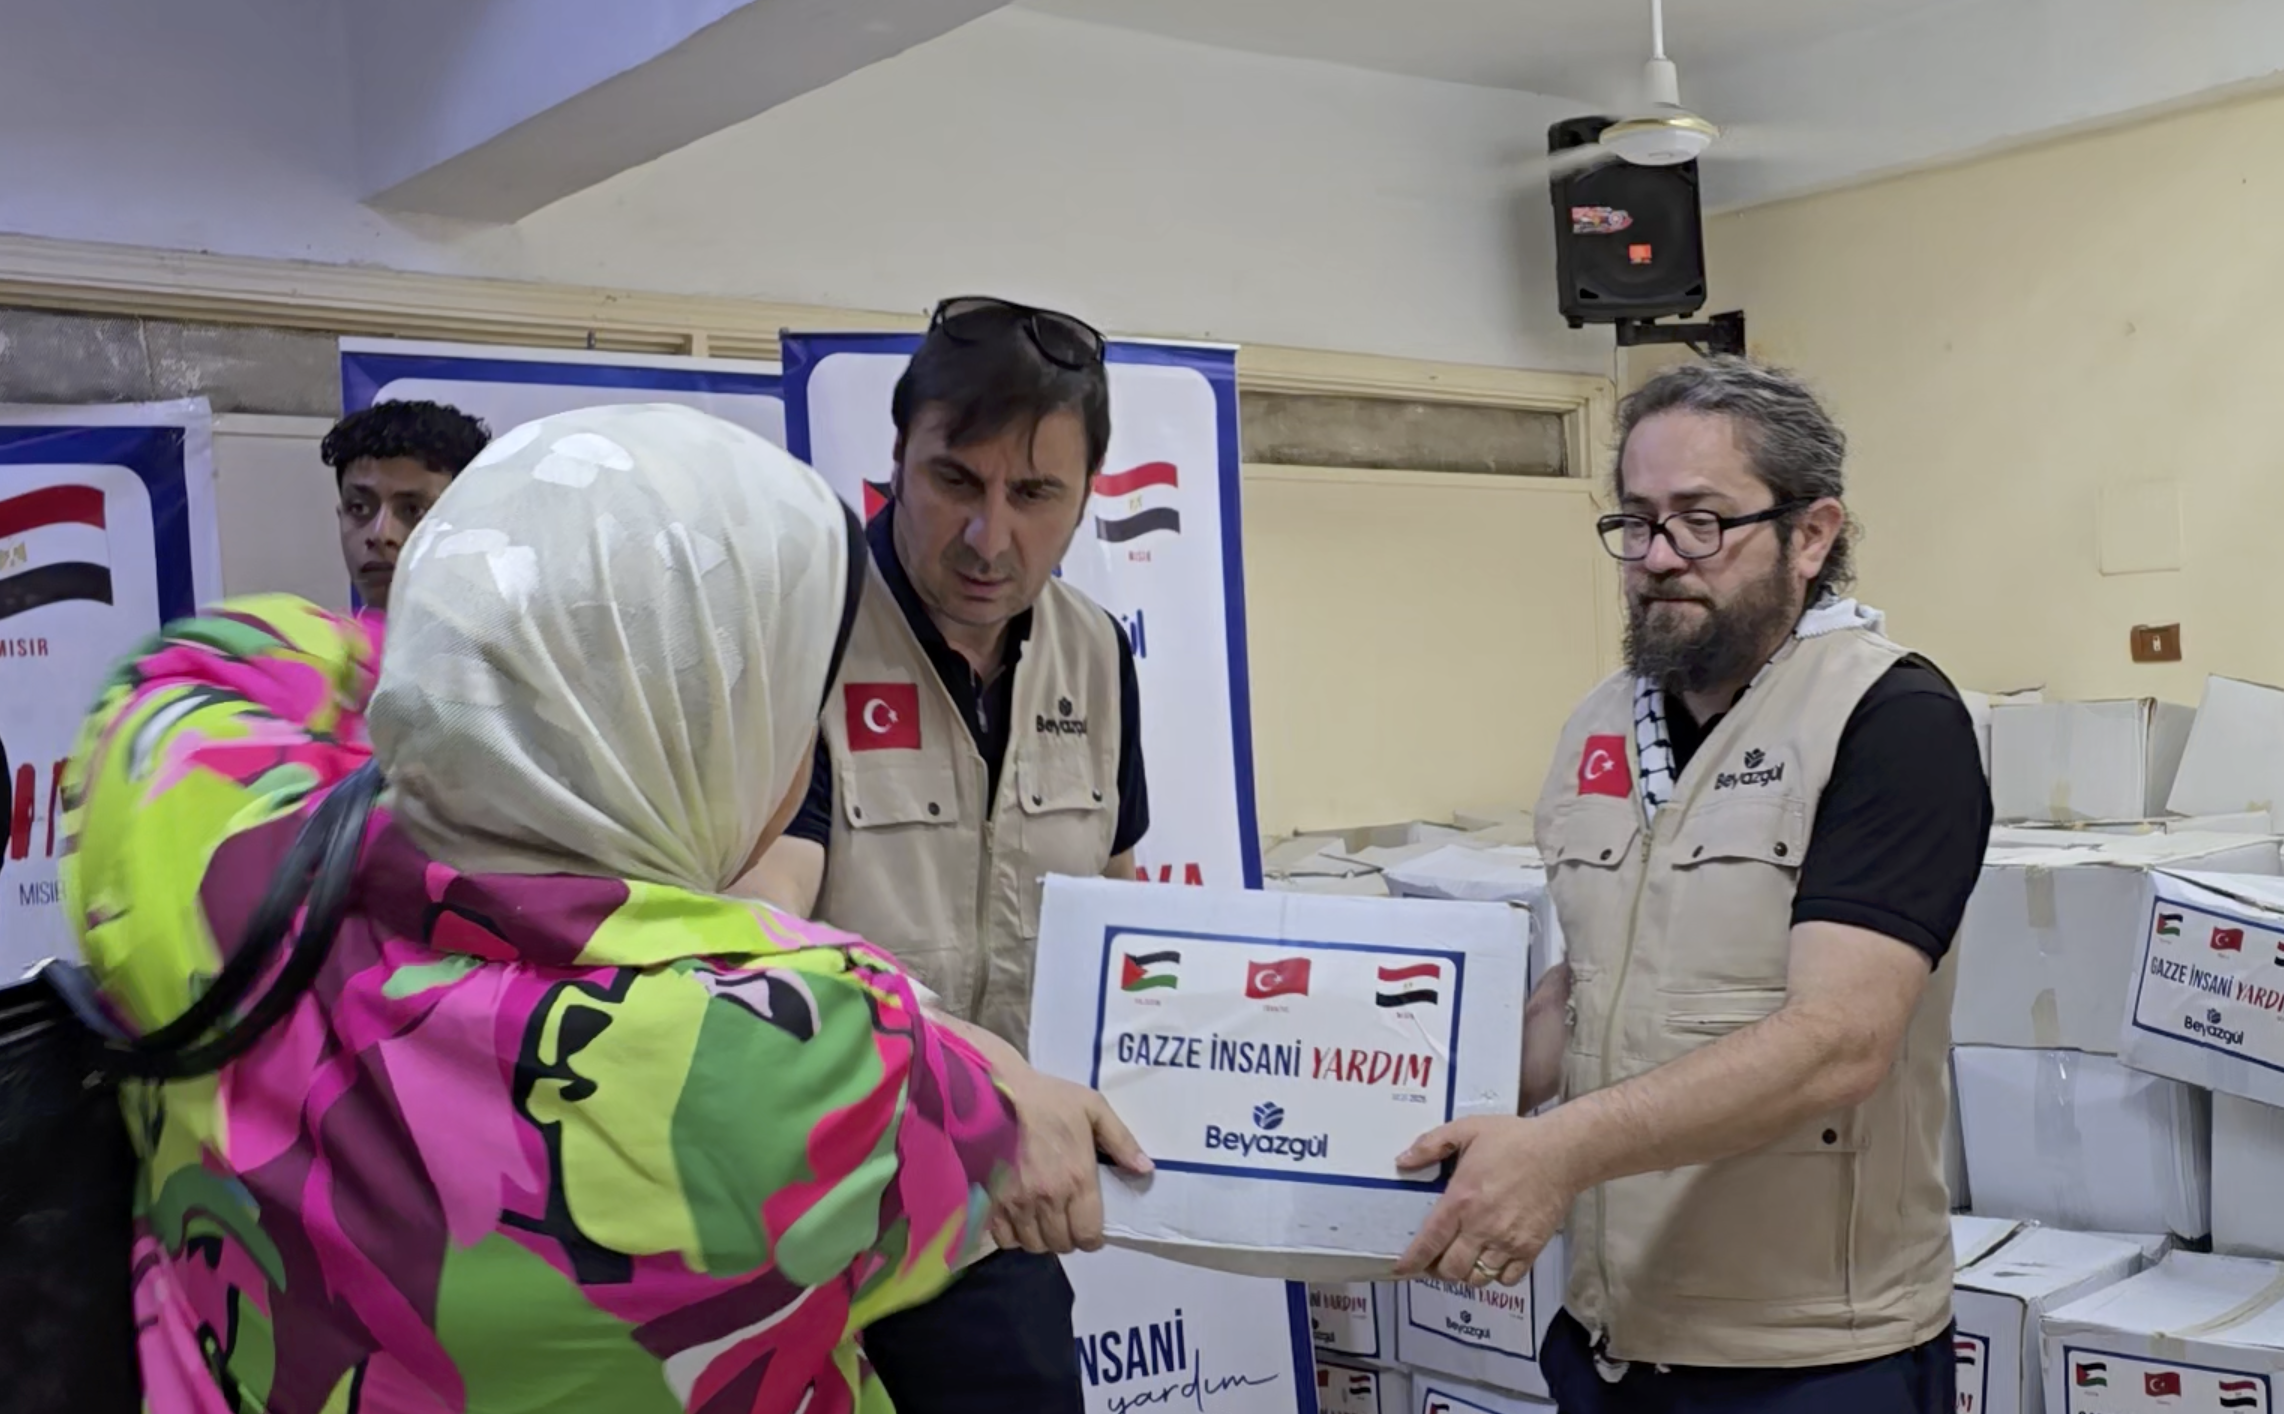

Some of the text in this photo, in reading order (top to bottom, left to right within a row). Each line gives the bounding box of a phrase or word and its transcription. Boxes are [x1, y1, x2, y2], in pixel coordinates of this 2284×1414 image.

[2150, 956, 2284, 1012] GAZZE İNSANİ YARDI
[2184, 1015, 2245, 1046] Beyazgül
[1118, 1032, 1433, 1088] GAZZE İNSANİ YARDIM
[1205, 1124, 1329, 1162] Beyazgül
[1074, 1308, 1187, 1386] NSANİ
[1107, 1348, 1280, 1414] yardım
